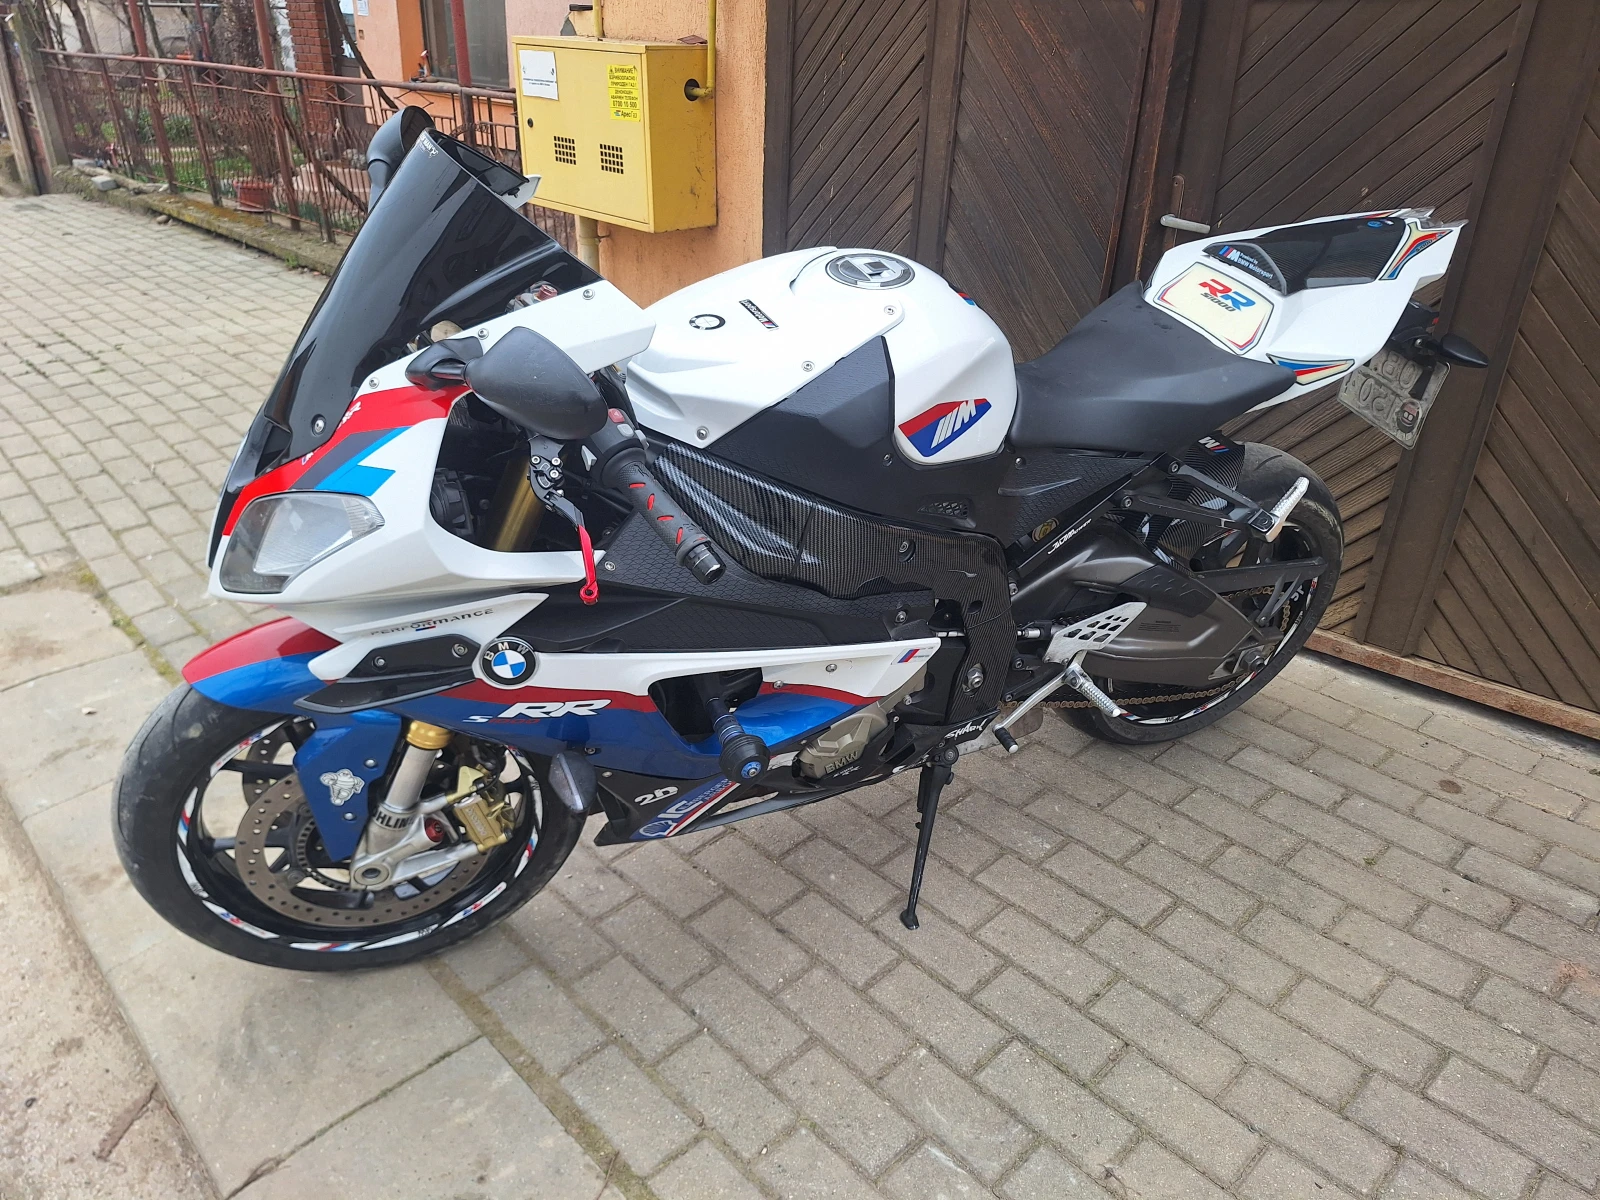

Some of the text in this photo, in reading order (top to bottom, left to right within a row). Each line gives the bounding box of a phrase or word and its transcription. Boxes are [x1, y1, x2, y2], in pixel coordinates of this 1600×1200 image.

[614, 67, 634, 75] ВНИМАНИЕ
[1238, 258, 1273, 280] BMW Motorsport
[1198, 278, 1256, 311] RR
[1200, 292, 1236, 312] S1000
[370, 608, 494, 636] PERFORMANCE
[497, 699, 612, 718] RR
[824, 751, 858, 774] BMW
